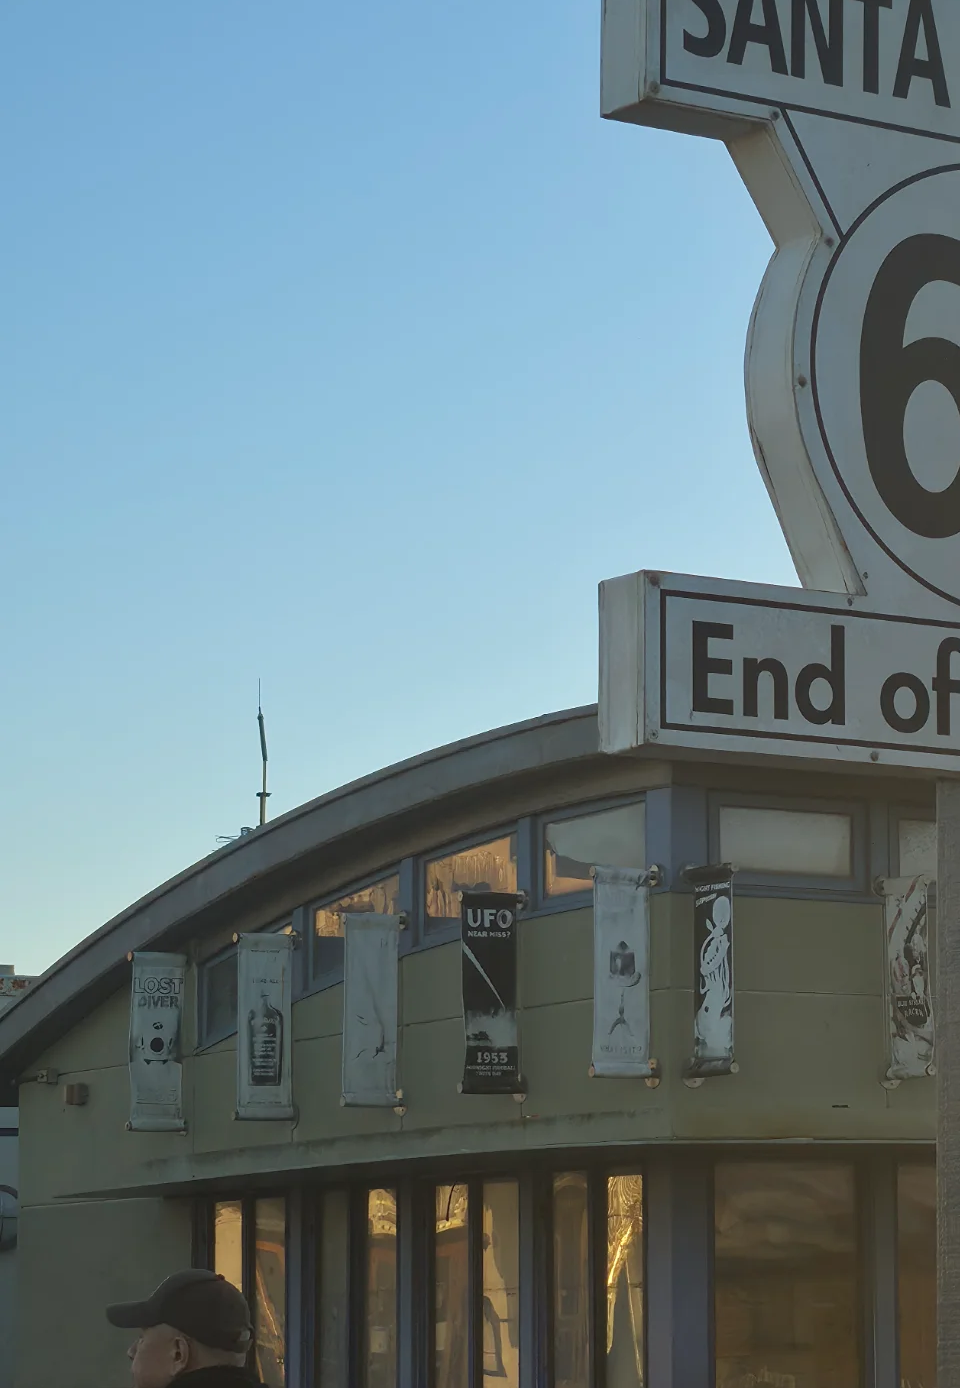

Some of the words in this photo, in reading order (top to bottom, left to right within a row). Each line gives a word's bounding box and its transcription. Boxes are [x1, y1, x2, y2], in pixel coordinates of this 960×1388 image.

[690, 619, 846, 726] End
[467, 908, 513, 929] UFO
[467, 930, 488, 938] NEAR
[489, 930, 511, 938] MISS?
[134, 977, 183, 994] LOST
[137, 995, 180, 1009] DIVER
[476, 1051, 508, 1064] 1953
